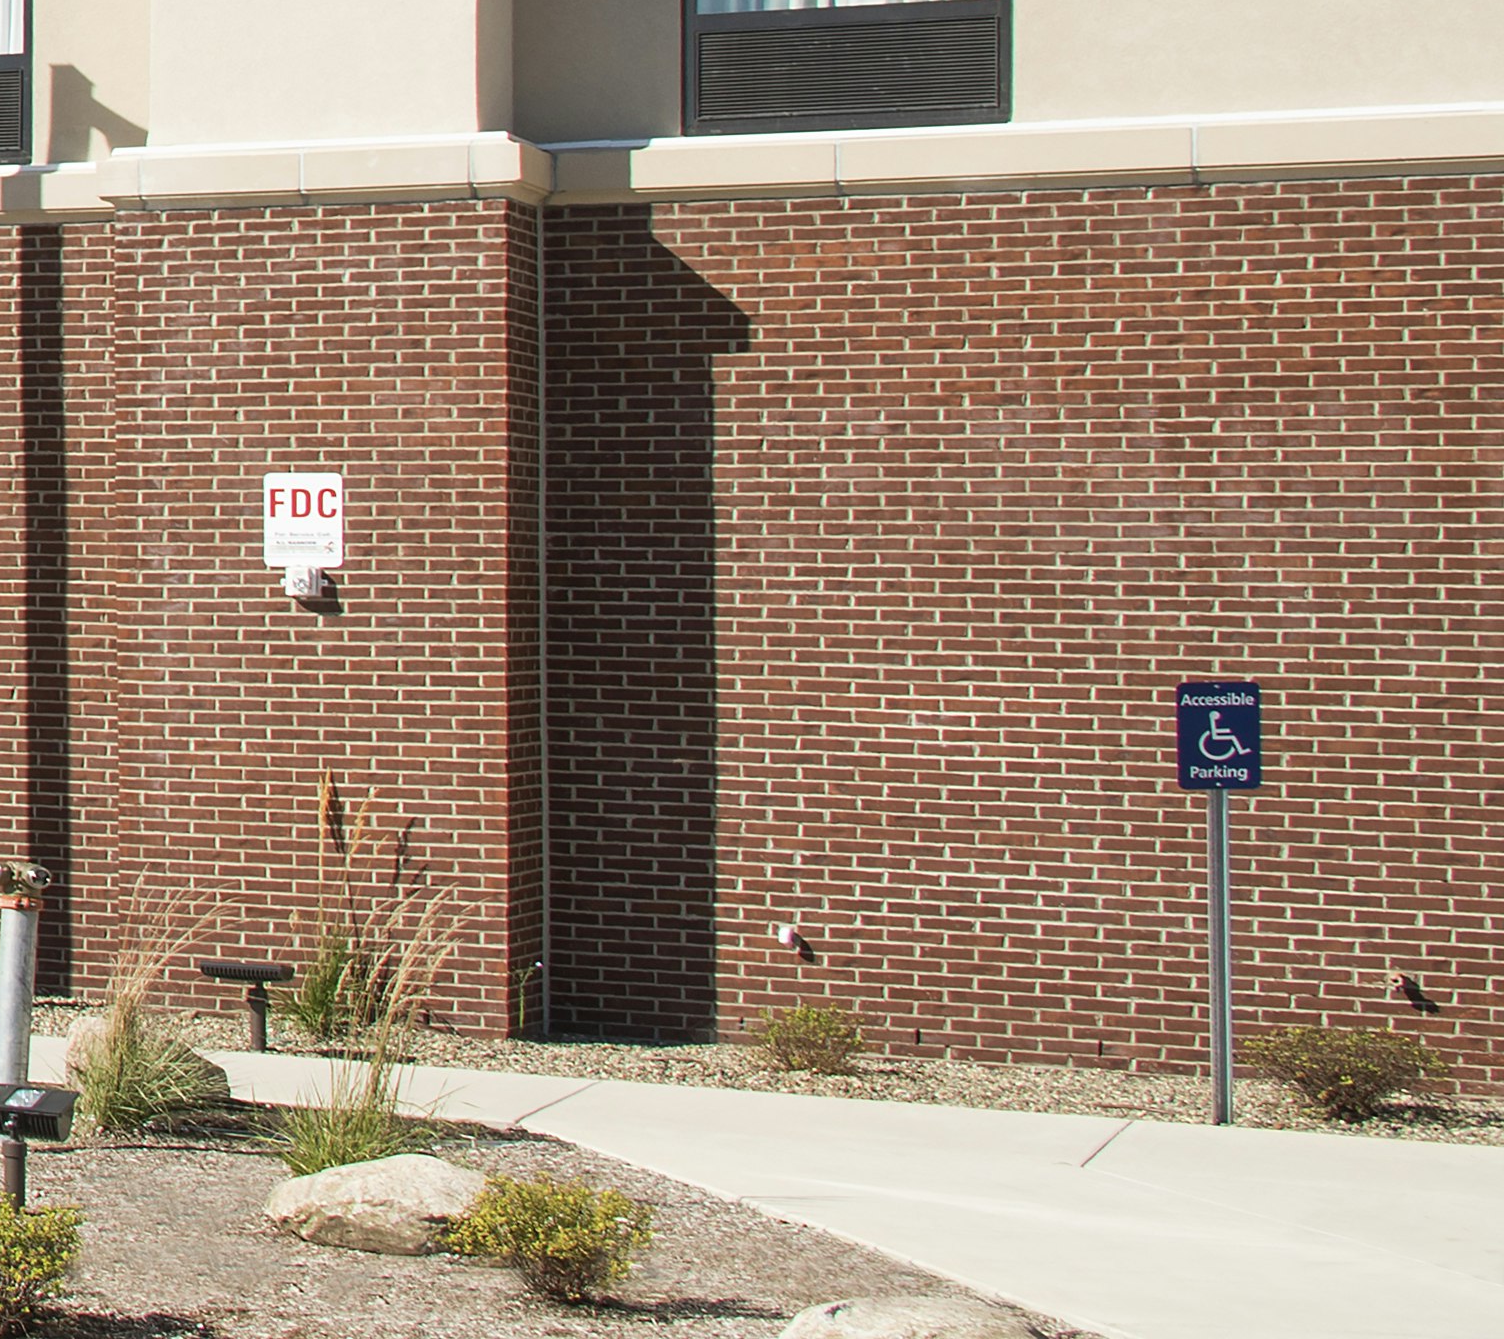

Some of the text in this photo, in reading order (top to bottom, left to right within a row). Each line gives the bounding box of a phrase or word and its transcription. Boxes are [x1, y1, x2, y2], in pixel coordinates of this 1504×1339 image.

[269, 488, 338, 518] FDC
[1180, 692, 1255, 705] Accessible
[1189, 765, 1248, 781] Parking
